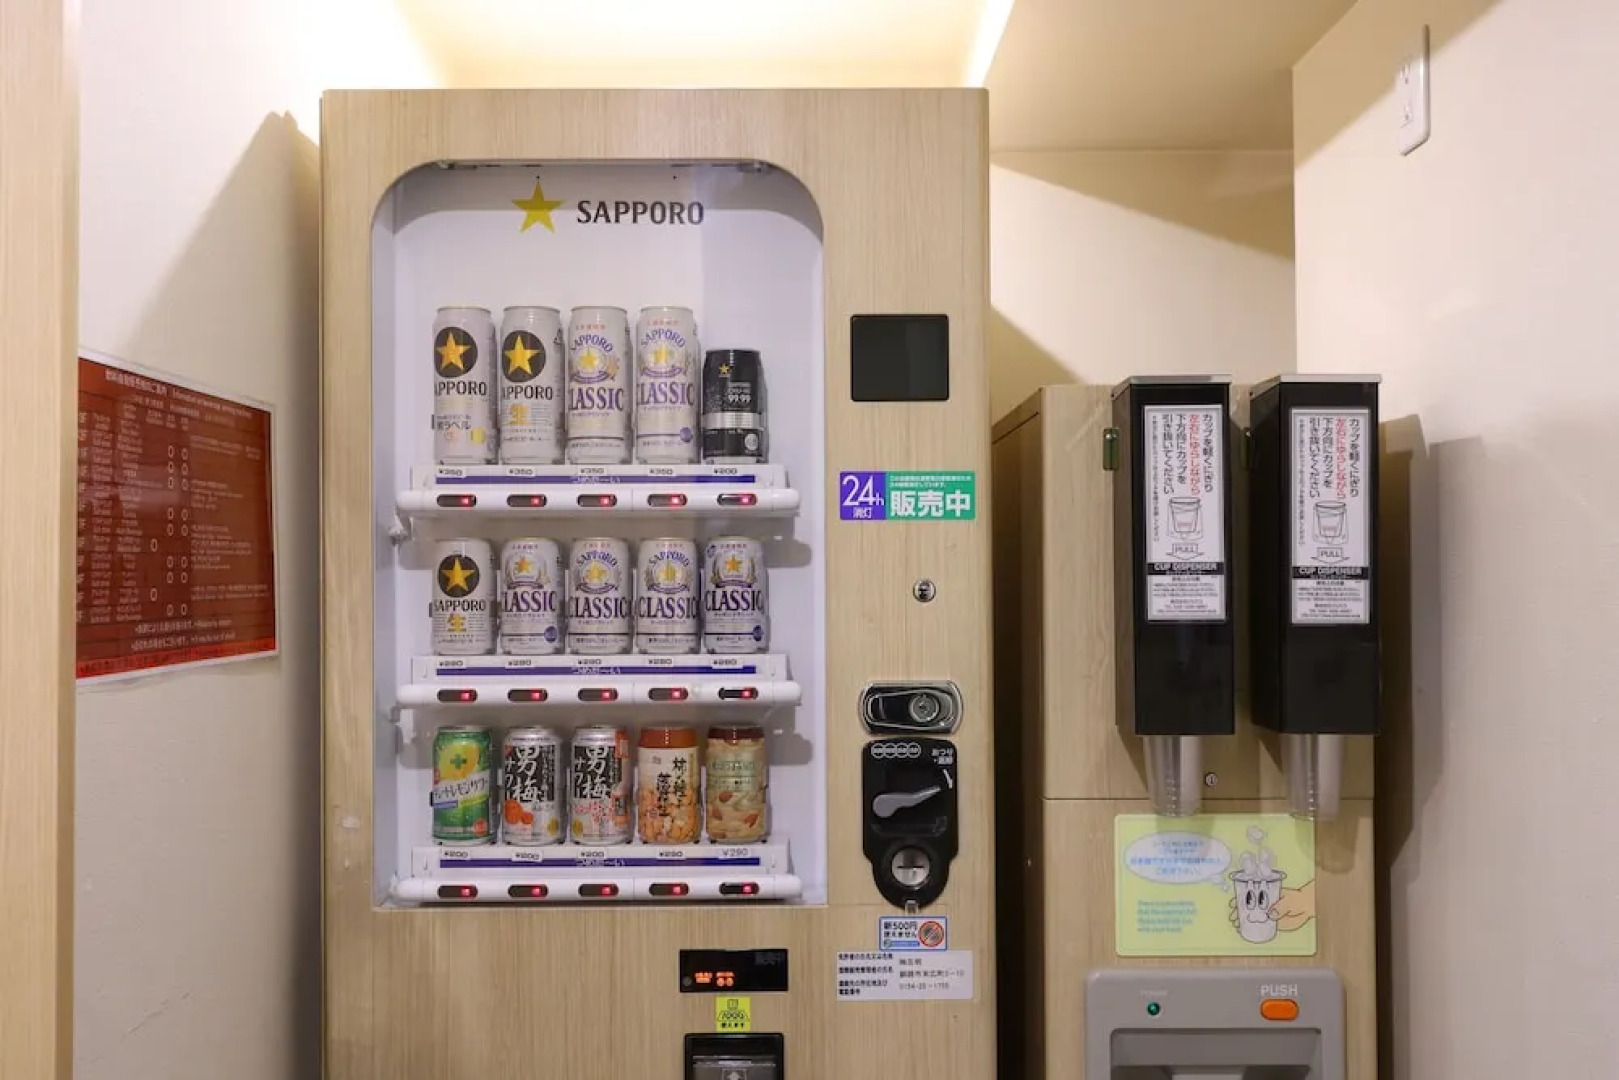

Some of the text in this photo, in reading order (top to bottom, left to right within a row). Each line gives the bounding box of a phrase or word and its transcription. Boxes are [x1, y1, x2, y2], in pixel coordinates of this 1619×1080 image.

[577, 200, 705, 225] SAPPORO
[569, 387, 624, 412] LASSIC
[637, 381, 695, 406] LASSIC
[890, 489, 971, 518] 販売中
[1320, 549, 1340, 558] PULL
[433, 599, 487, 612] SAPPORO
[503, 590, 557, 612] LASSIC
[705, 589, 764, 611] CLASSIC
[1260, 984, 1298, 997] PUSH
